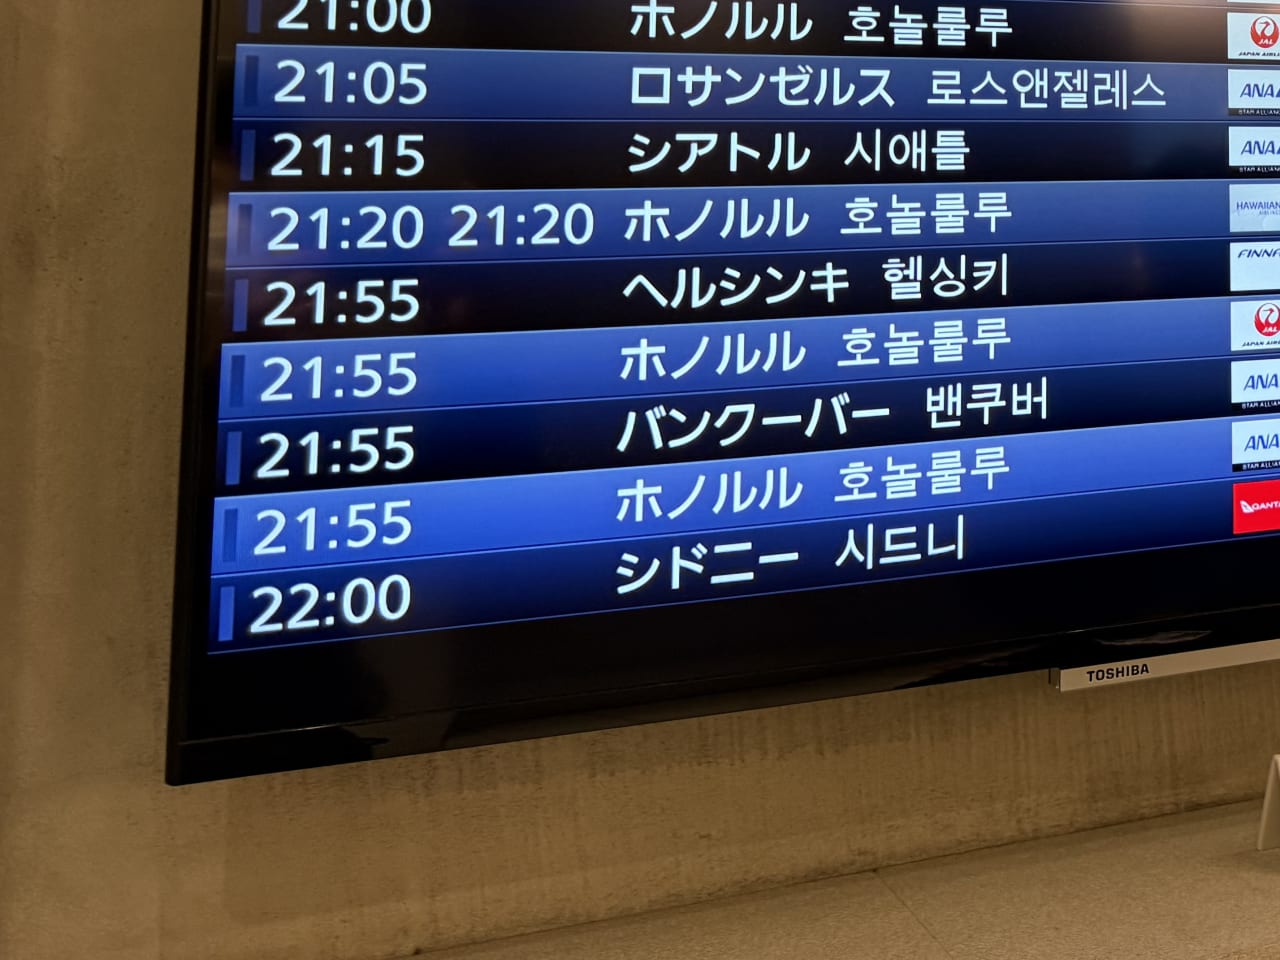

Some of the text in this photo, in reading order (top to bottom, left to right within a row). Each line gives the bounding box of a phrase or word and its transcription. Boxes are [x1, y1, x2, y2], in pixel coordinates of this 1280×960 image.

[843, 4, 1013, 48] 호놀룰루
[275, 59, 427, 105] 21:05
[631, 64, 896, 107] ロサンゼルス
[927, 67, 1166, 111] 로스앤젤레스
[1240, 83, 1274, 98] ANA
[270, 132, 426, 177] 21:15
[628, 131, 811, 173] シアトル
[844, 128, 970, 173] 시애틀
[267, 205, 425, 251] 21:20
[448, 202, 594, 247] 21:20
[624, 196, 810, 242] ホノルル
[840, 192, 1012, 236] 호놀룰루
[623, 261, 849, 309] ヘルシンキ
[882, 252, 1007, 301] 헬싱키
[263, 278, 419, 326] 21:55
[620, 330, 807, 381] ホノルル
[837, 317, 1011, 367] 호놀룰루
[260, 352, 418, 401] 21:55
[617, 391, 890, 452] バンクーバー
[926, 376, 1048, 429] 밴쿠버
[257, 425, 415, 479] 21:55
[833, 446, 1010, 502] 호놀룰루
[616, 467, 804, 522] ホノルル
[253, 499, 413, 555] 21:55
[835, 514, 964, 570] 시드니
[616, 541, 799, 595] シドニー
[250, 573, 412, 633] 22:00
[1086, 664, 1149, 682] TOSHIBA
